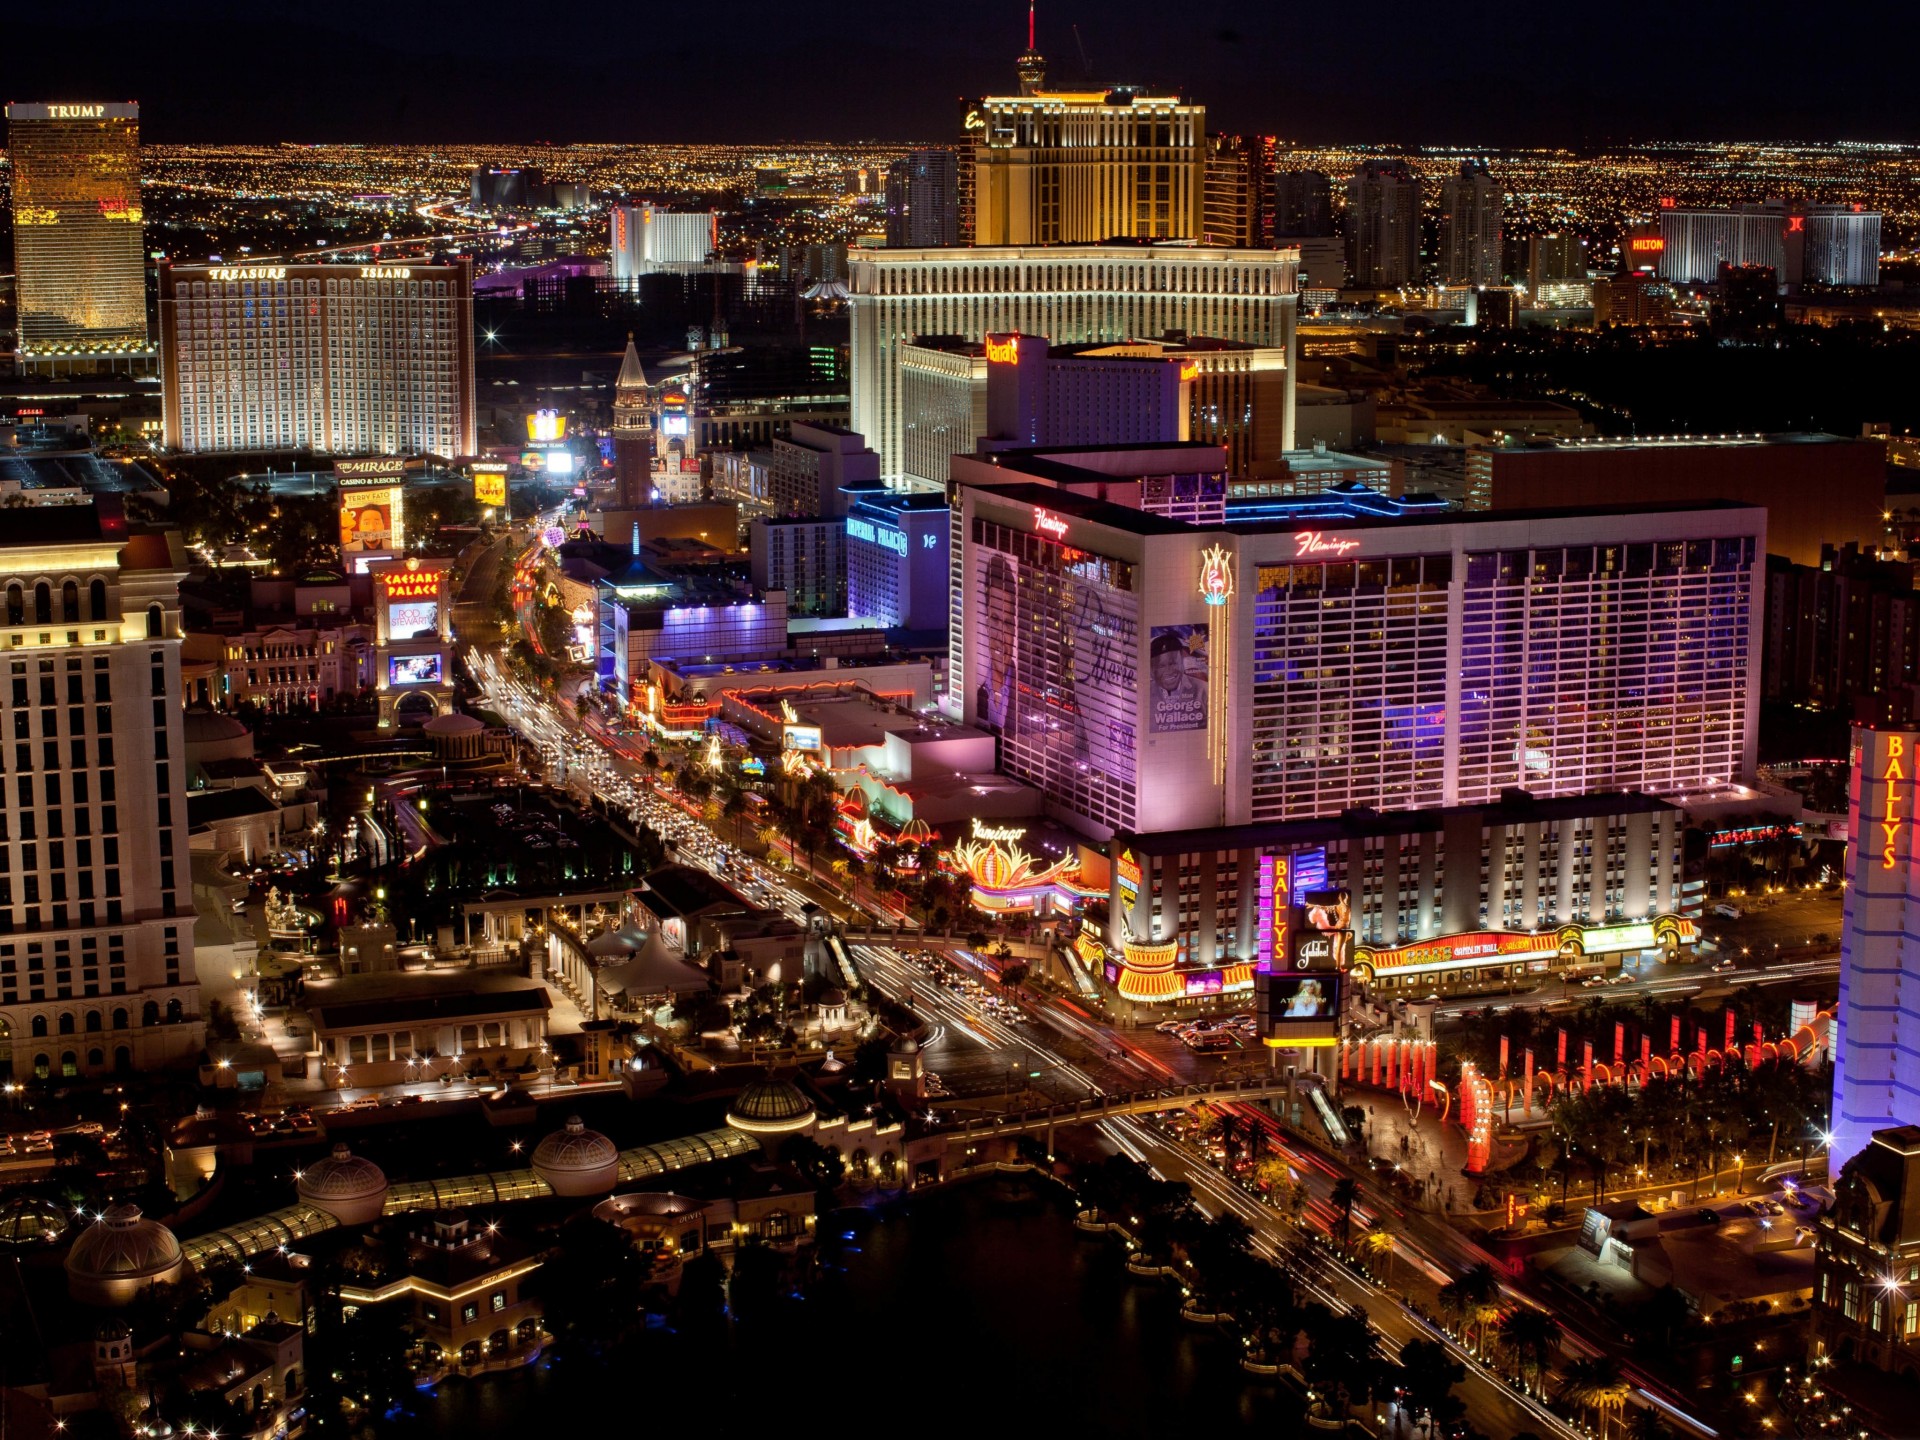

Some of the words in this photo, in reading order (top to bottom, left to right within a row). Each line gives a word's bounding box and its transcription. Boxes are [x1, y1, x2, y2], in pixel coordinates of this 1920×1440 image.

[48, 105, 105, 118] TRUMP
[1633, 239, 1664, 250] HILTON
[209, 268, 286, 281] TREASURE
[361, 267, 411, 279] ISLAND
[986, 337, 1018, 365] Harrah's
[352, 460, 403, 473] MIRAGE
[340, 478, 366, 486] CASINO
[373, 476, 401, 484] RESORT
[347, 494, 371, 502] TERRY
[1034, 507, 1069, 540] Flamingo
[1294, 531, 1360, 556] Flamingo
[385, 573, 439, 584] CAESARS
[388, 584, 437, 596] PALACE
[399, 608, 420, 620] ROD
[391, 617, 428, 627] STEWART
[1156, 699, 1201, 712] George
[1154, 711, 1204, 724] Wallace
[1169, 721, 1199, 730] President
[1880, 735, 1905, 870] BALLYS
[1273, 860, 1289, 960] BALLYS
